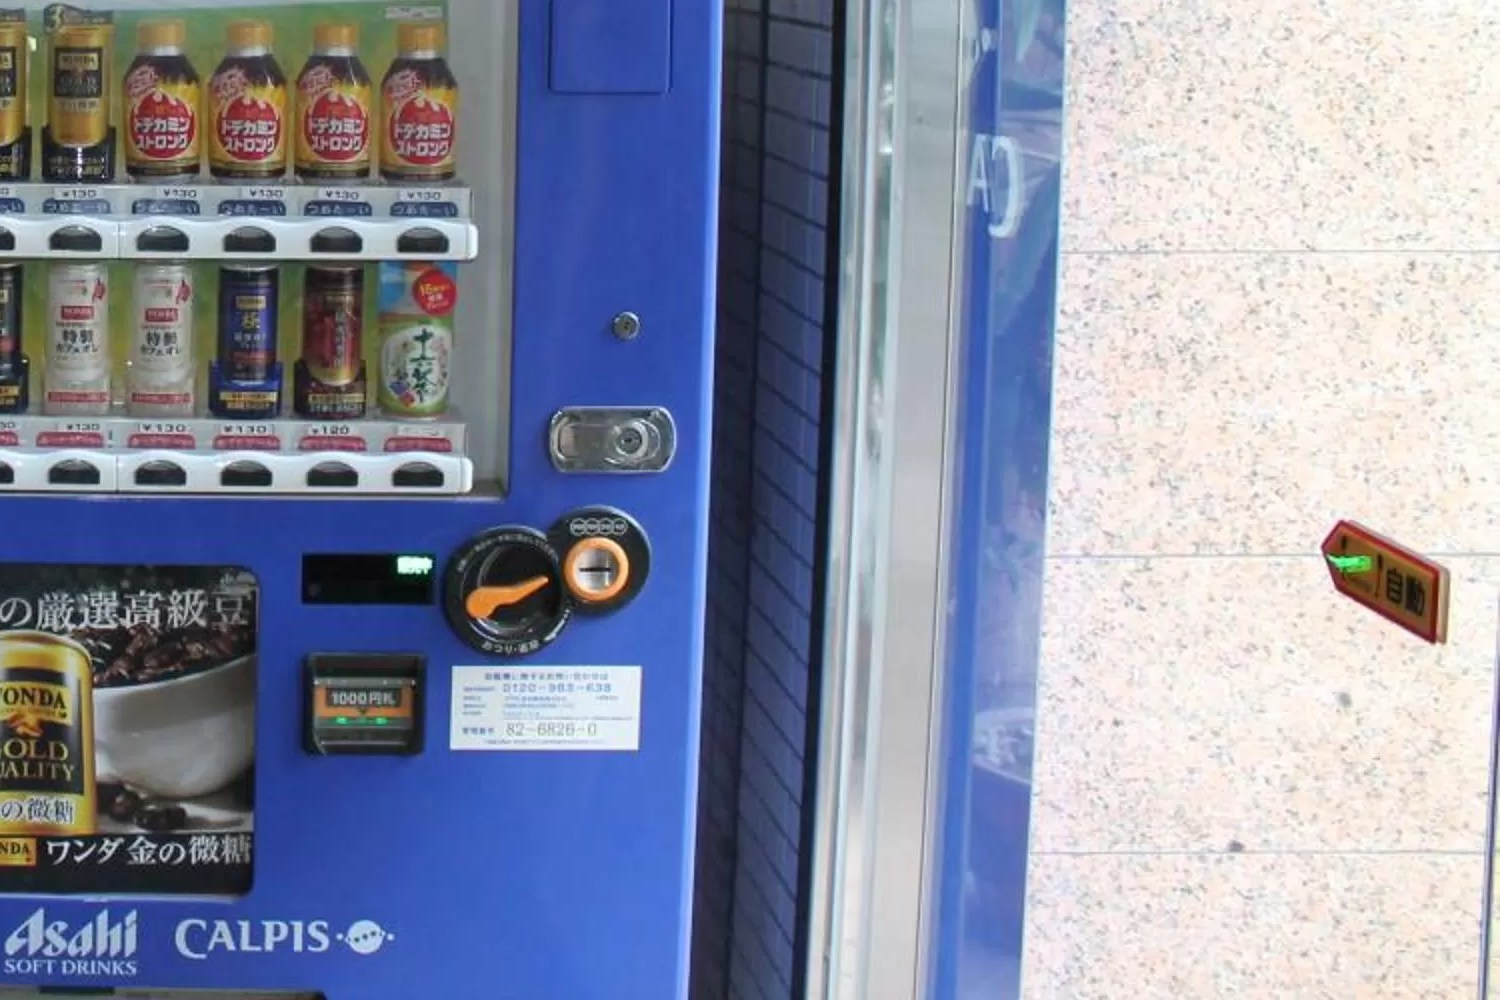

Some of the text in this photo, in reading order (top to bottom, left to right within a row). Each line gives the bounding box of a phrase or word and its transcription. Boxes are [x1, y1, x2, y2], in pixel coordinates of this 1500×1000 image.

[410, 327, 437, 403] 十六茶
[505, 721, 597, 737] 82-6826-0
[4, 908, 137, 958] Asahi
[174, 918, 330, 960] CALPIS
[3, 959, 137, 976] SOFT DRINKS
